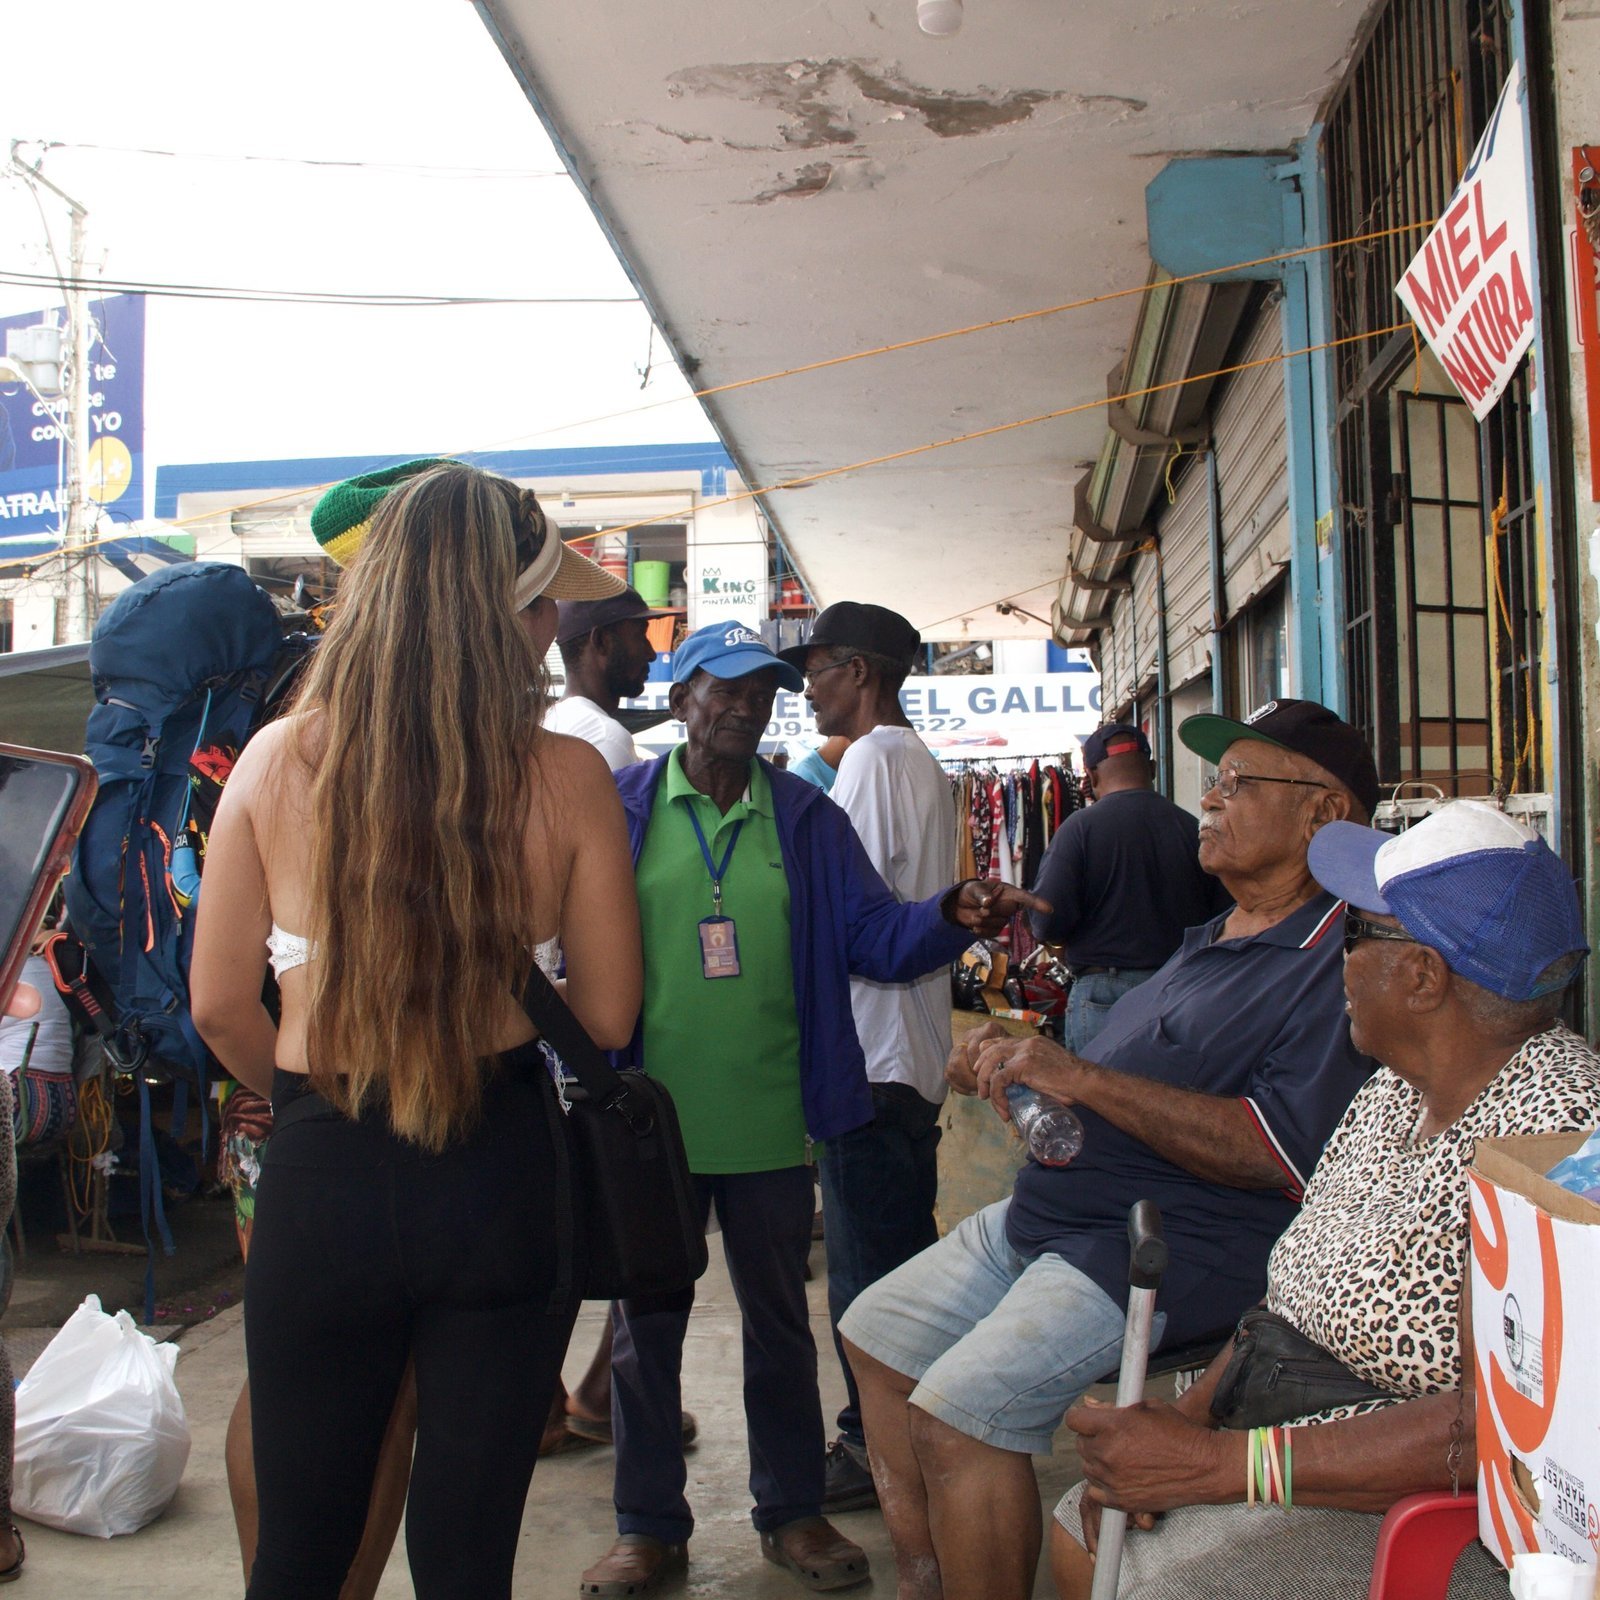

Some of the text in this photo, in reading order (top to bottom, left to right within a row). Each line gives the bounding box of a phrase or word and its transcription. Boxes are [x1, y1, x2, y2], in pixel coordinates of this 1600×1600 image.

[1406, 179, 1507, 340] MIEL
[1441, 250, 1533, 411] NATURA
[95, 364, 116, 381] te
[92, 411, 122, 433] YO
[1543, 1465, 1586, 1508] HARVEST
[1556, 1494, 1586, 1528] BELLE
